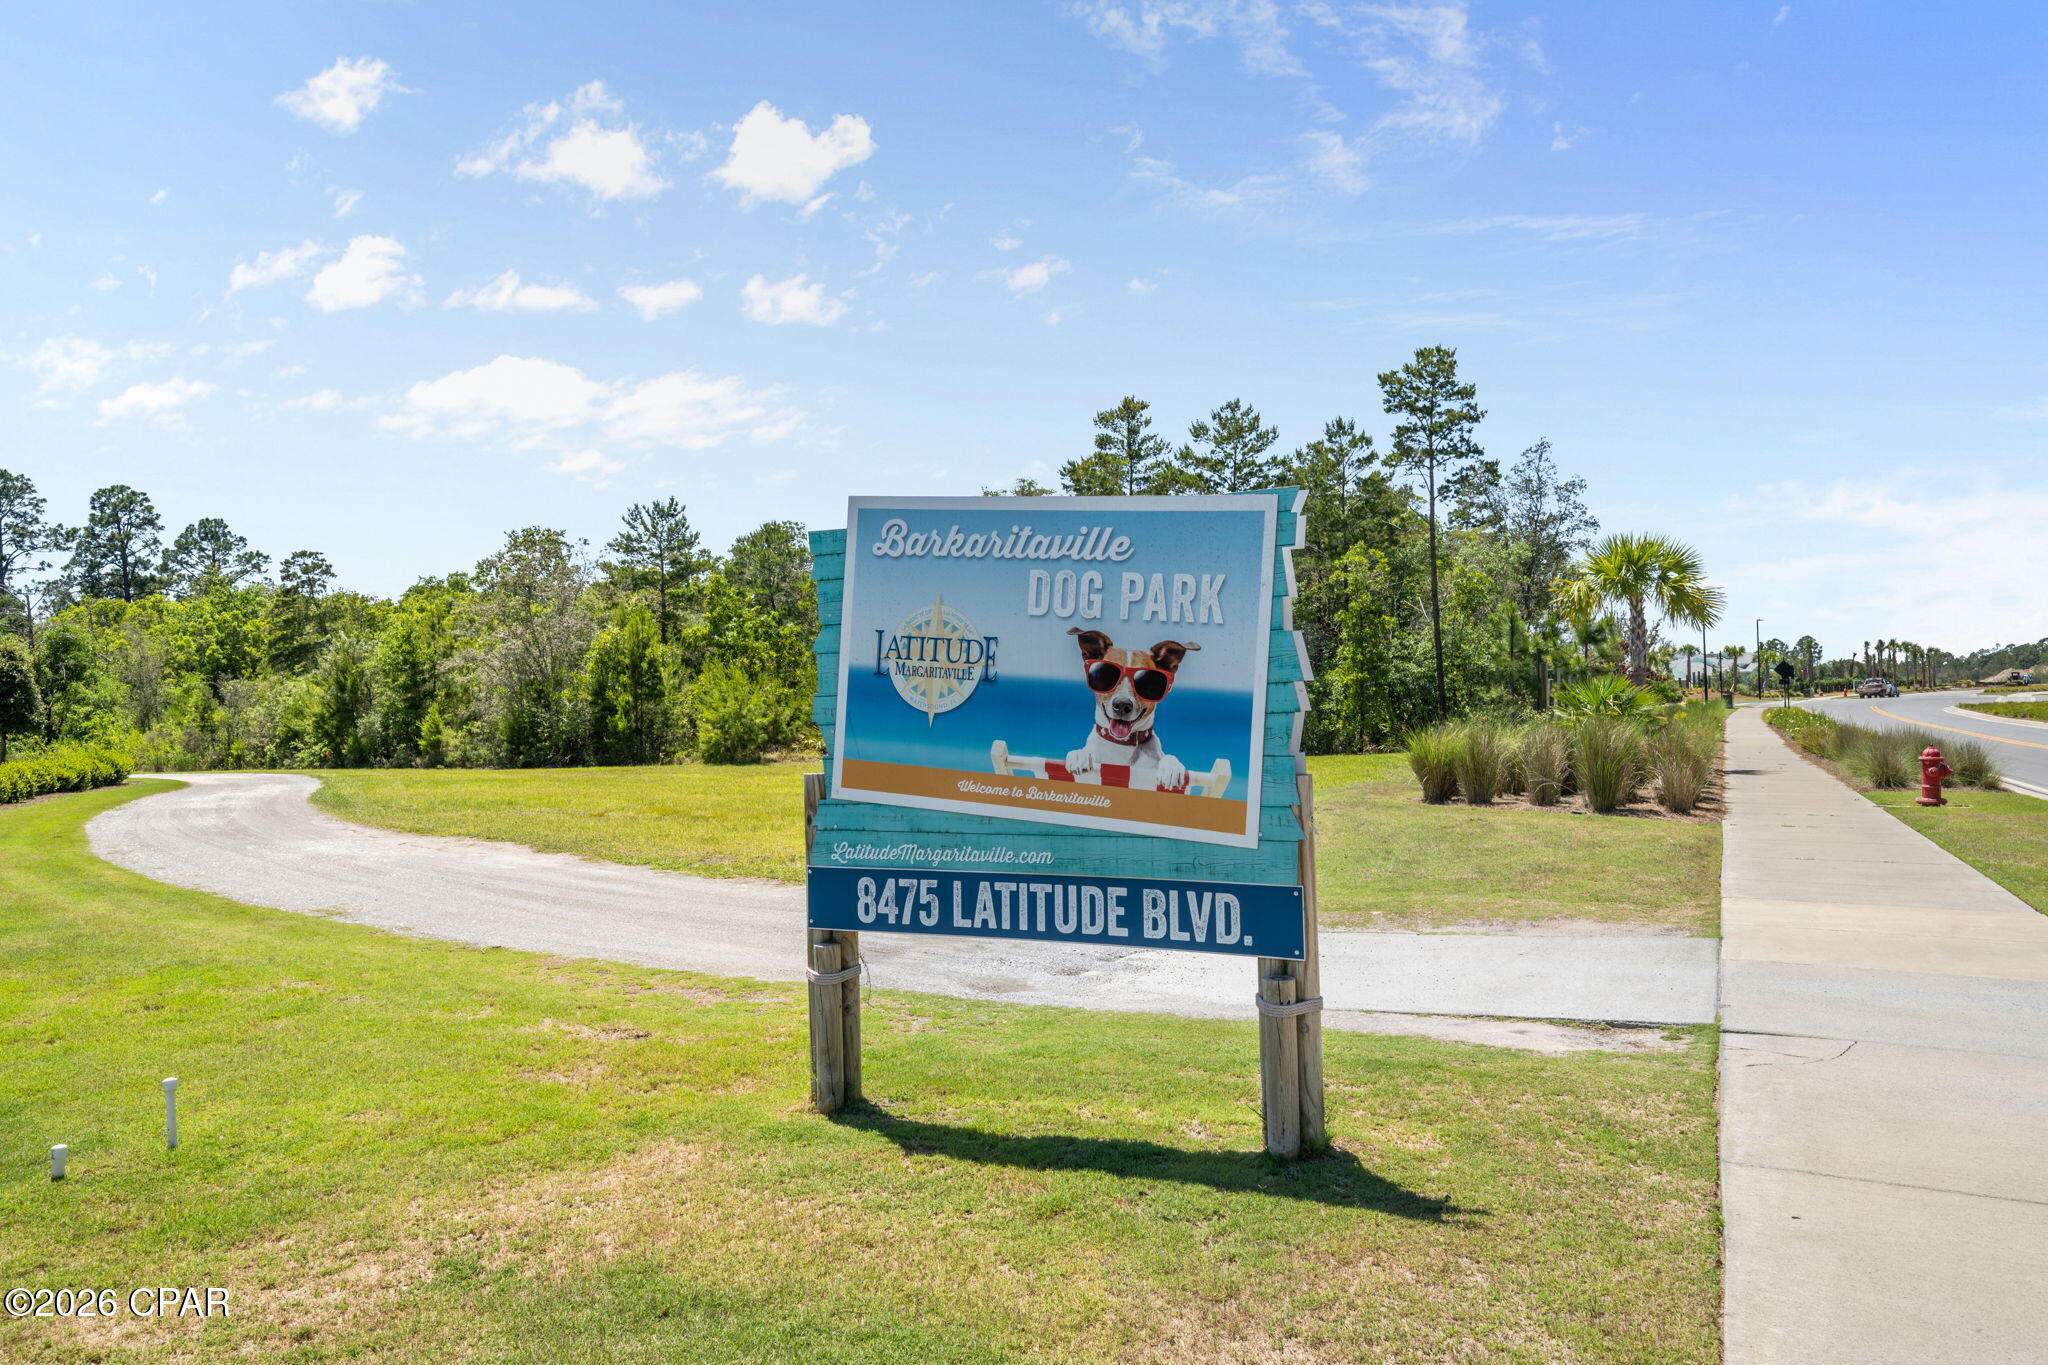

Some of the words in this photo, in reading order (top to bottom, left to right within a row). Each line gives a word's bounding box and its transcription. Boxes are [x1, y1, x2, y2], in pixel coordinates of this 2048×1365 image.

[872, 518, 1135, 562] Barkaritaville
[1027, 569, 1103, 619] DOG
[1119, 571, 1226, 625] PARK
[873, 629, 999, 681] LATITUDE
[895, 661, 975, 681] MARGARITAVILLE
[957, 779, 1010, 797] Welcome
[1011, 785, 1024, 798] to
[1025, 786, 1113, 808] Barkaritaville
[831, 841, 1055, 867] LatitudeMargaritaville.com
[857, 876, 939, 927] 8475
[952, 880, 1129, 938] LATITUDE
[1143, 888, 1253, 946] BLVD.
